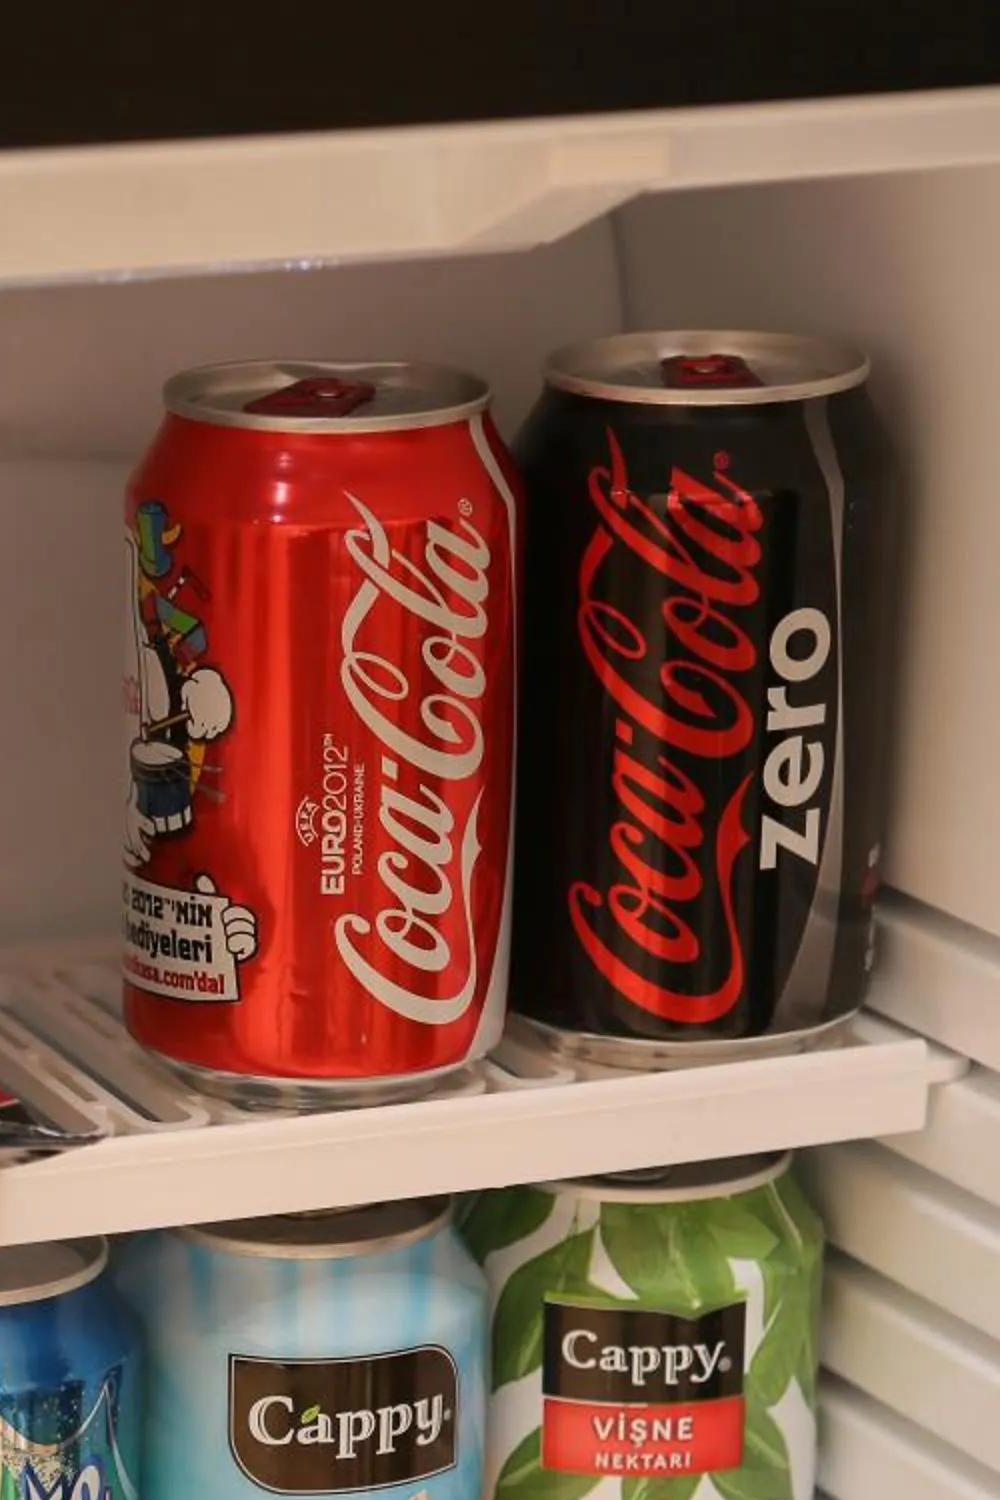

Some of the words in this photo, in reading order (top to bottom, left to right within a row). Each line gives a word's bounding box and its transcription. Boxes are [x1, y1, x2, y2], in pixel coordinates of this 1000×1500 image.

[759, 607, 831, 870] zero
[562, 1330, 724, 1385] Cappy
[248, 1393, 445, 1461] Cappy
[593, 1412, 693, 1448] VİŞNE
